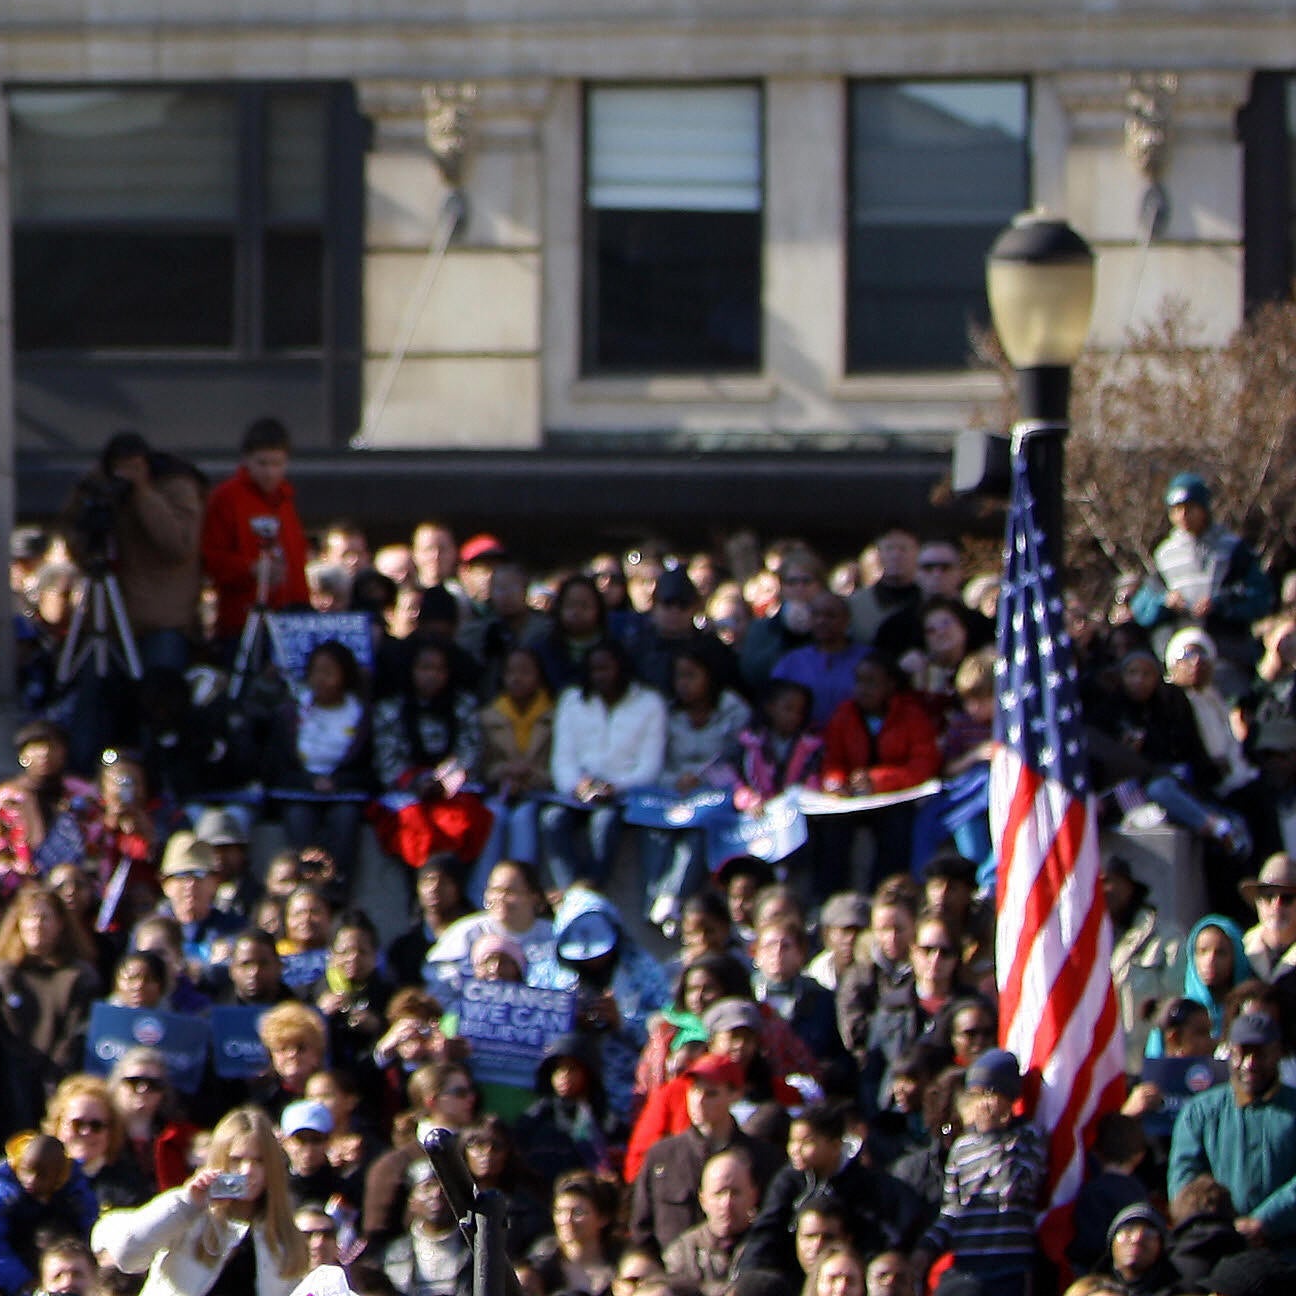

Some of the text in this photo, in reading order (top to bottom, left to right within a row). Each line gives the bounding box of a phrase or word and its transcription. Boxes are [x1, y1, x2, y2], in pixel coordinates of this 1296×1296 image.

[463, 981, 570, 1012] CHANGE
[461, 1003, 570, 1032] WE CAN
